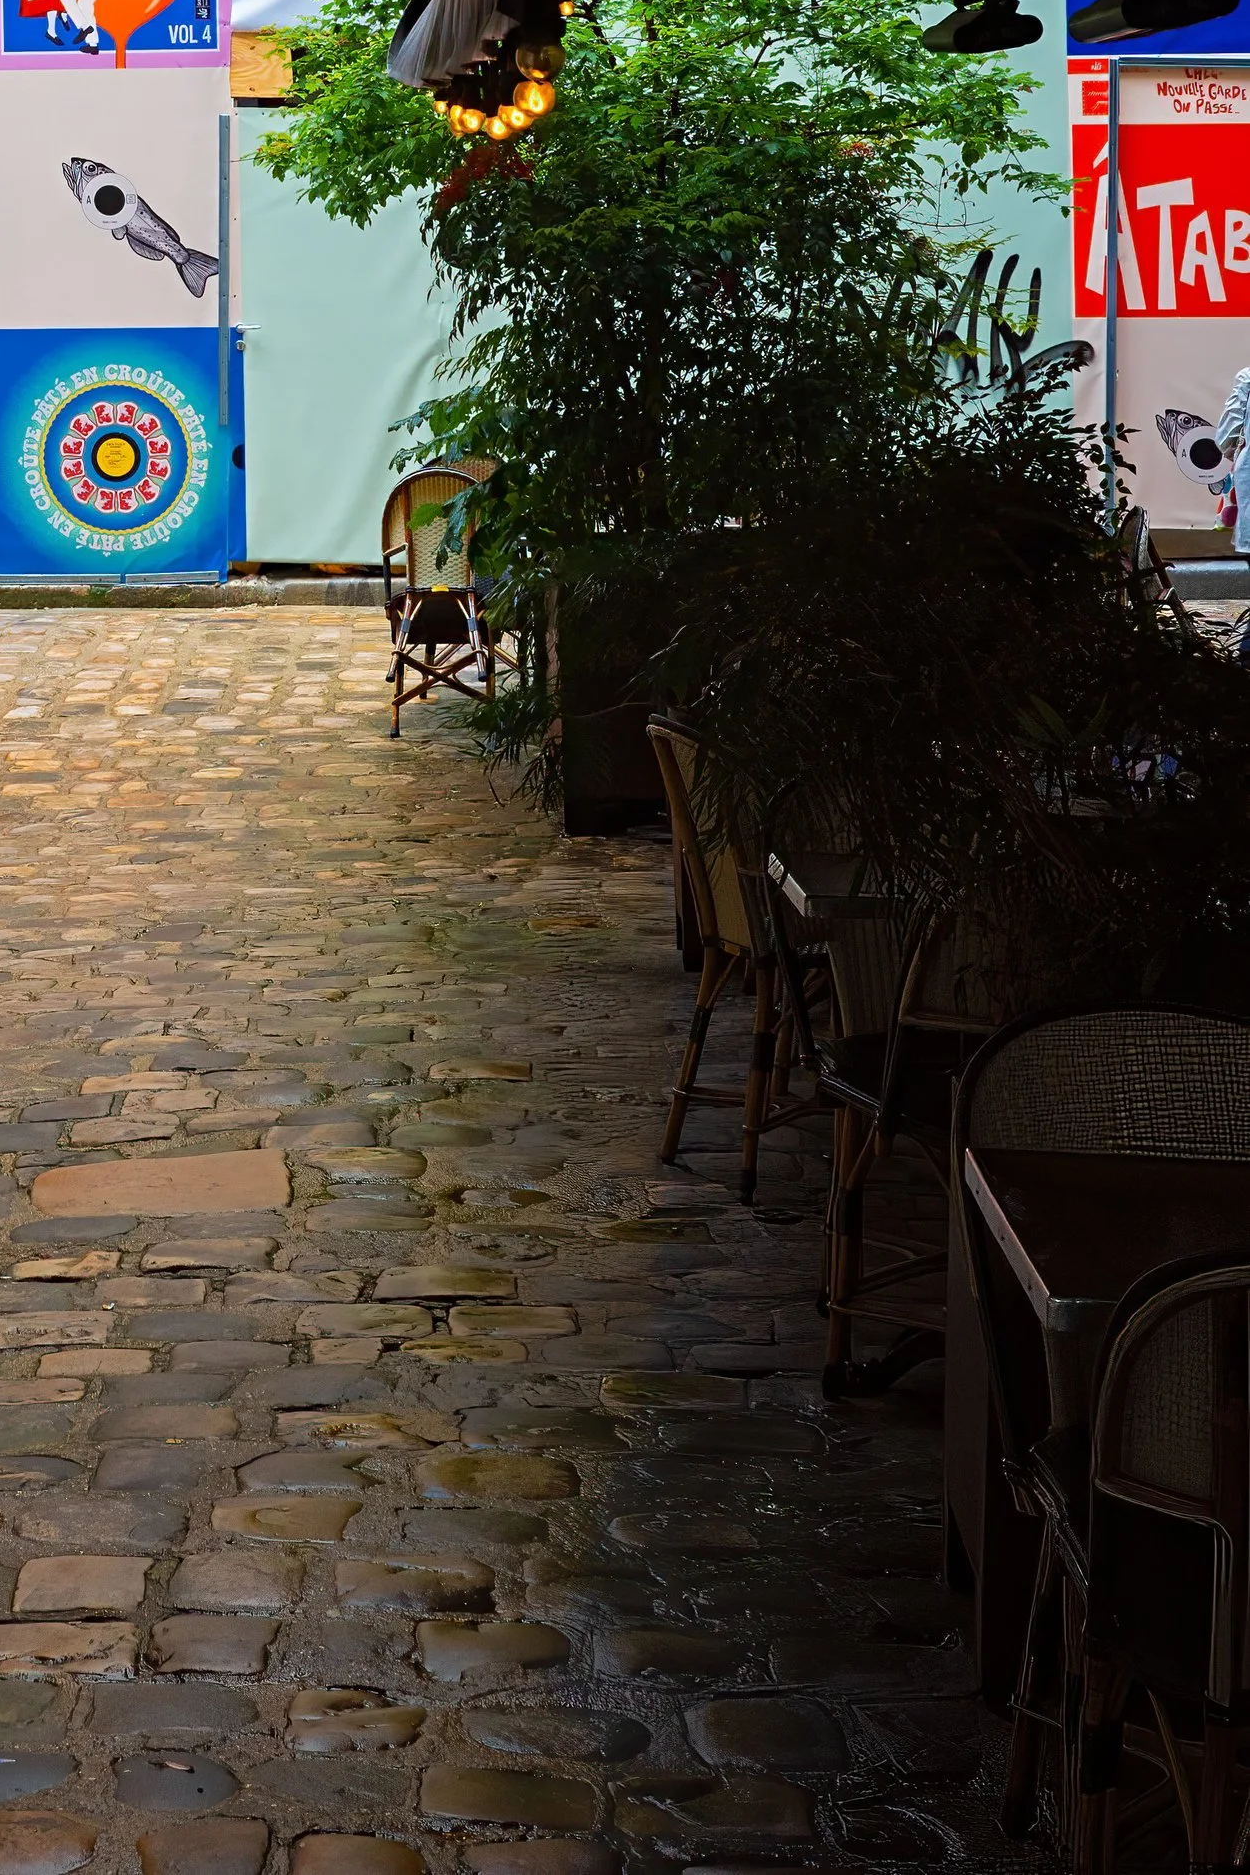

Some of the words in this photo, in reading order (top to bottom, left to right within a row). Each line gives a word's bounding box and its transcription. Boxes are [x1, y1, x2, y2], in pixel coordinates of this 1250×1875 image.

[168, 24, 198, 44] VOL
[202, 23, 212, 44] 4
[1156, 81, 1205, 98] NOUVELLE
[1208, 83, 1247, 101] GARDE
[1173, 98, 1191, 114] ON
[86, 195, 92, 205] A
[70, 366, 100, 390] EN
[104, 364, 185, 405] CROÛTE
[31, 378, 72, 430] PÂTÉ
[1181, 448, 1187, 458] A
[190, 458, 209, 488] EN
[47, 510, 78, 538] EN
